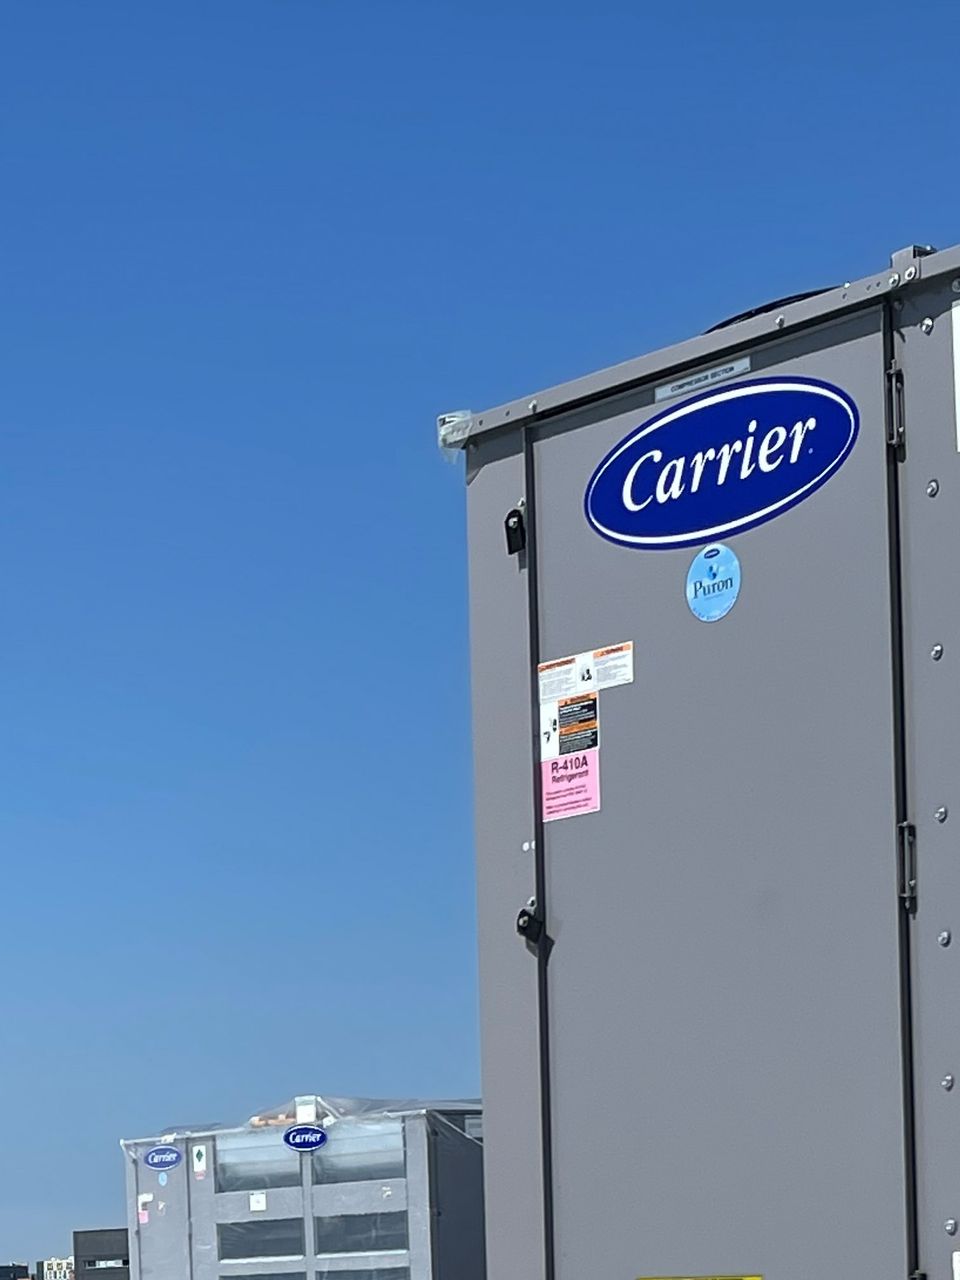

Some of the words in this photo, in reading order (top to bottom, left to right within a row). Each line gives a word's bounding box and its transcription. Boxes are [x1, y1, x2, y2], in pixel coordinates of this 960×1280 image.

[622, 416, 817, 513] Carrier
[693, 577, 734, 600] Puron
[551, 754, 589, 774] R-410A
[289, 1131, 322, 1144] Carrier
[148, 1151, 178, 1164] Carrier
